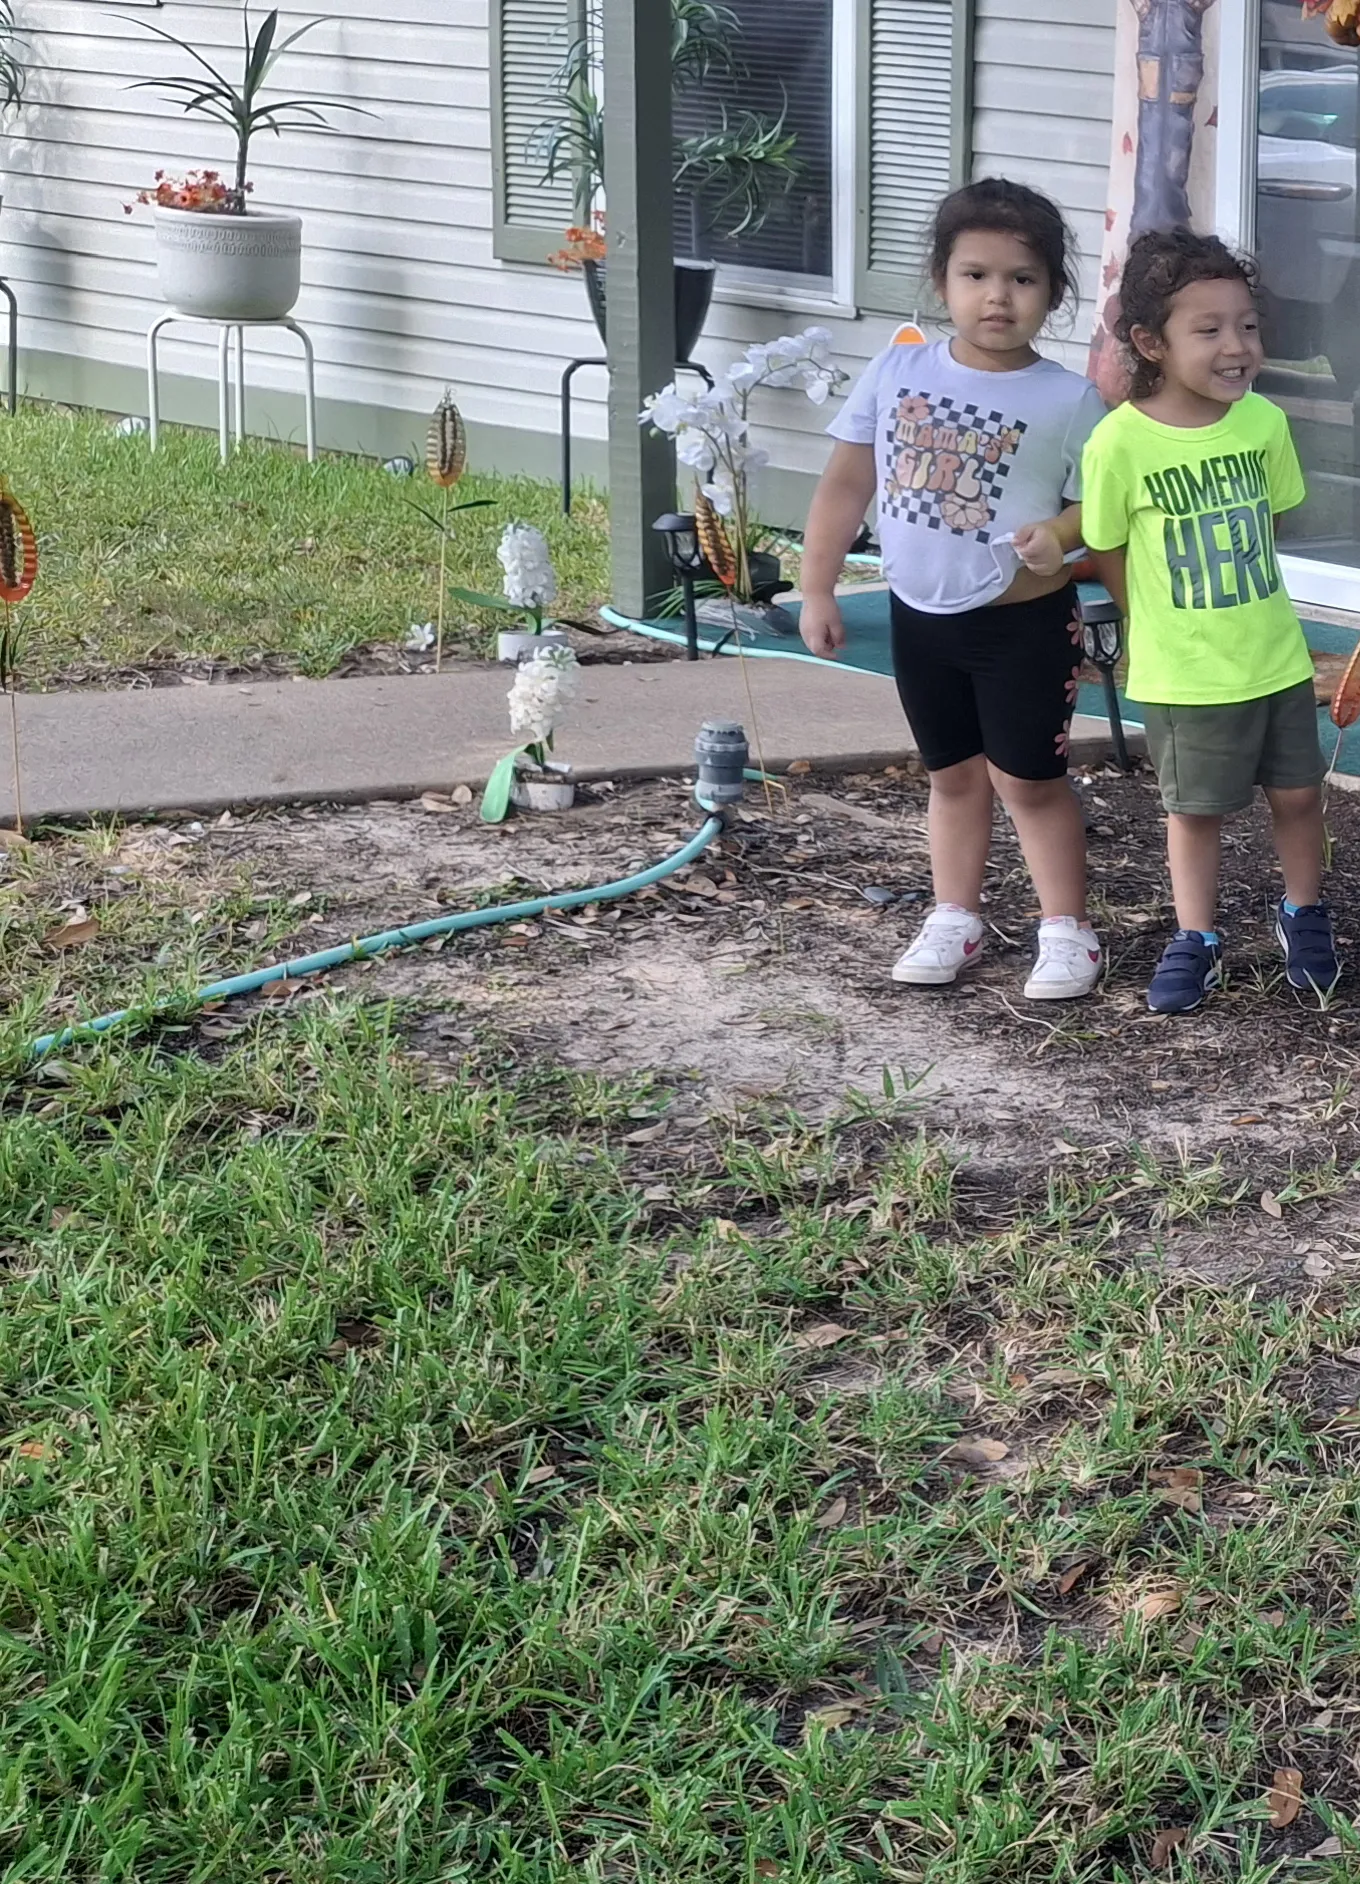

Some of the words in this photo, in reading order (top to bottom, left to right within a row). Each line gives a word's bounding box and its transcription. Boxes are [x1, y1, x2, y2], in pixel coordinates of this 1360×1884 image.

[895, 416, 1002, 464] MAMA'S
[894, 446, 982, 502] GIRL
[1143, 449, 1269, 517] HOMERUN
[1163, 498, 1279, 610] HERO
